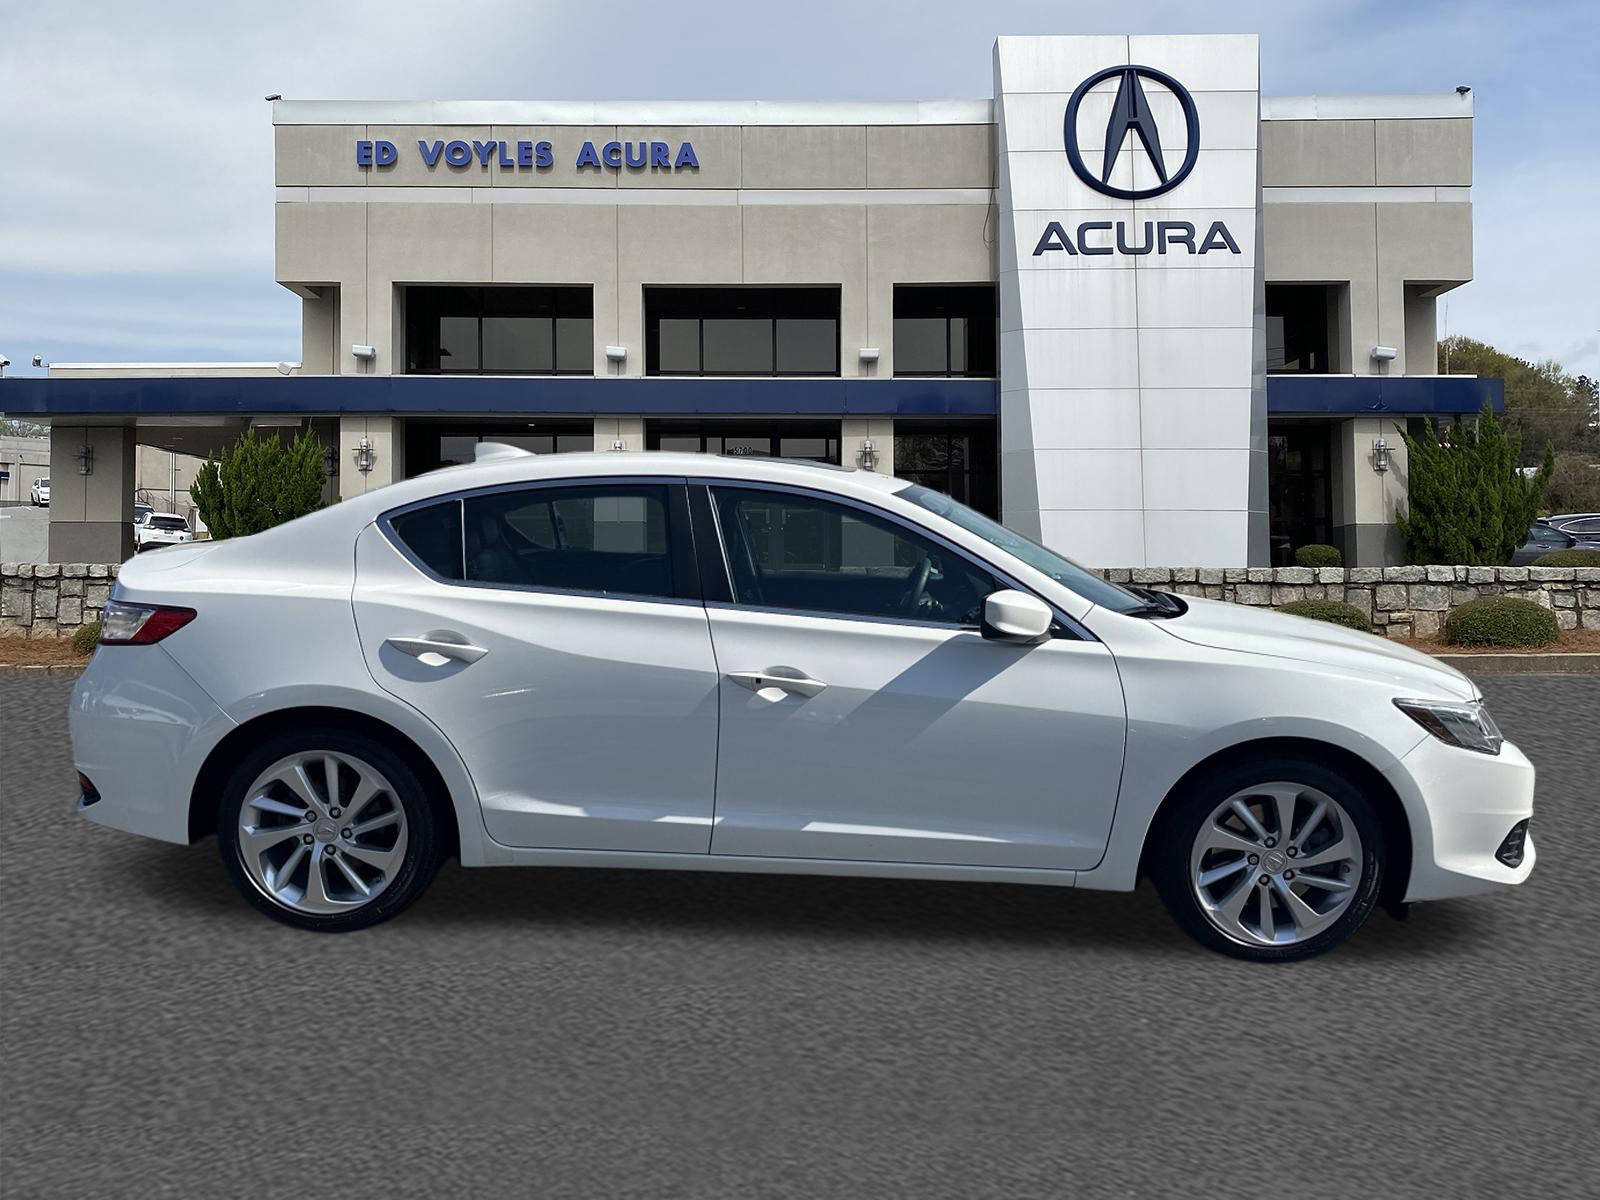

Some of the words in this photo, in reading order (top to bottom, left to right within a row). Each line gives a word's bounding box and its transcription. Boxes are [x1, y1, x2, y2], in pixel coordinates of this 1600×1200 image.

[356, 139, 398, 166] ED
[417, 140, 555, 167] VOYLES
[576, 141, 700, 169] ACURA
[1032, 221, 1242, 256] ACURA
